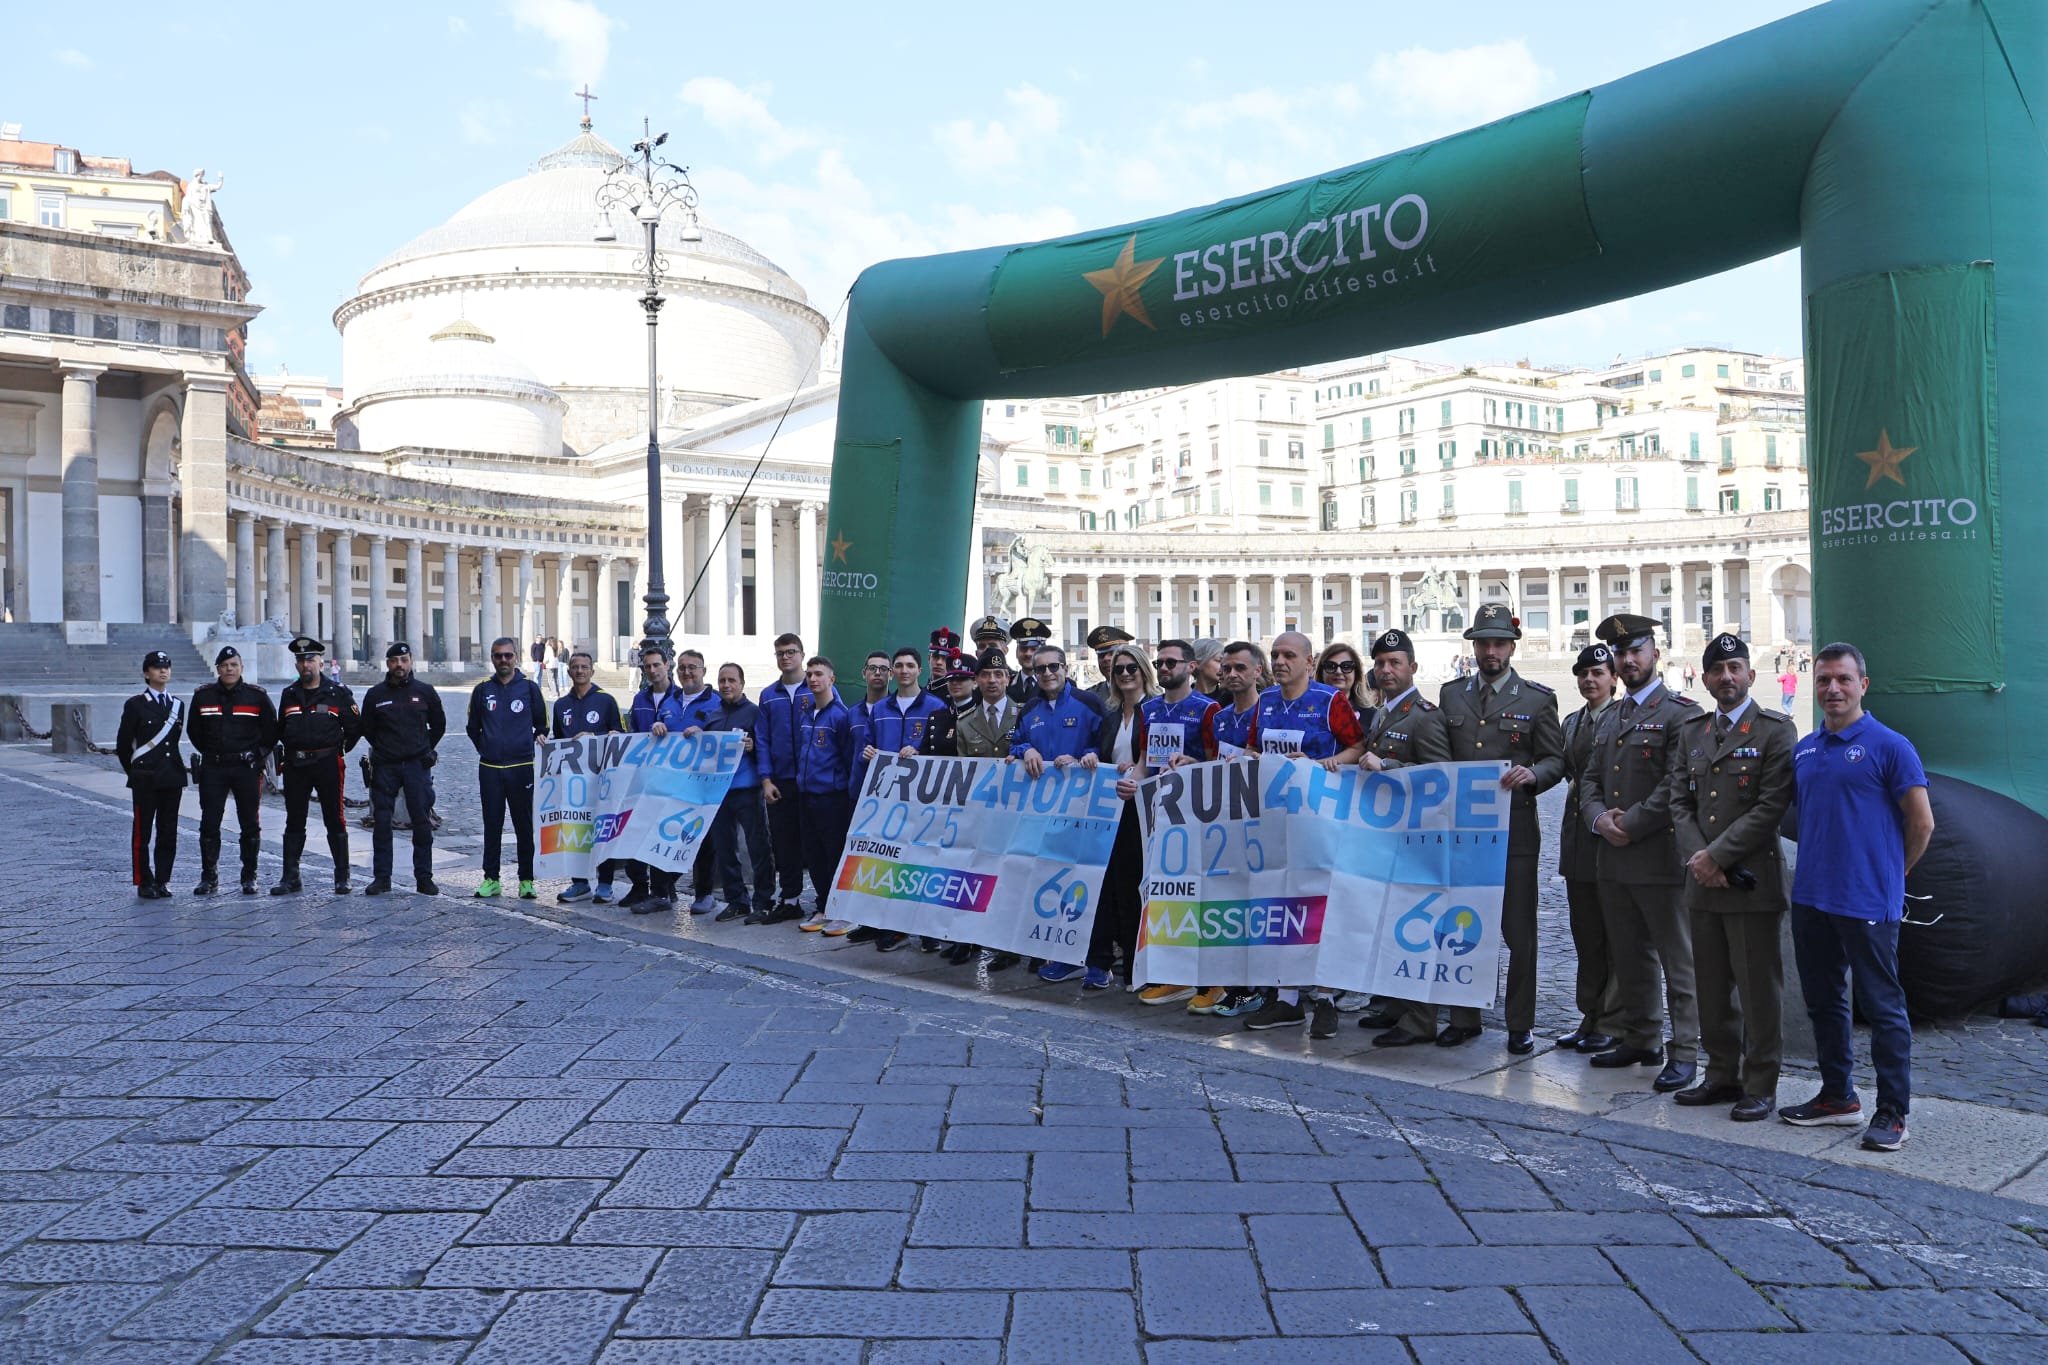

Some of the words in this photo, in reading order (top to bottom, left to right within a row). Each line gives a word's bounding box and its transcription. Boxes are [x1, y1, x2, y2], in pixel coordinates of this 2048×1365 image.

[1173, 193, 1429, 301] ESERCITO
[1179, 253, 1437, 327] esercito.difesa.it
[1821, 498, 1977, 536] ESERCITO
[823, 571, 877, 590] ERCITO
[540, 814, 547, 824] V
[549, 811, 592, 822] EDIZIONE
[852, 799, 965, 849] 2025
[1053, 819, 1112, 831] ITALIA
[556, 815, 622, 849] MAGEN
[1406, 834, 1498, 845] ITALIA
[650, 843, 691, 862] AIRC
[850, 840, 857, 851] V
[857, 840, 902, 859] EDIZIONE
[853, 863, 982, 906] MASSIGEN
[1147, 904, 1308, 940] MASSIGEN
[1029, 924, 1078, 946] AIRC
[1393, 960, 1473, 985] AIRC
